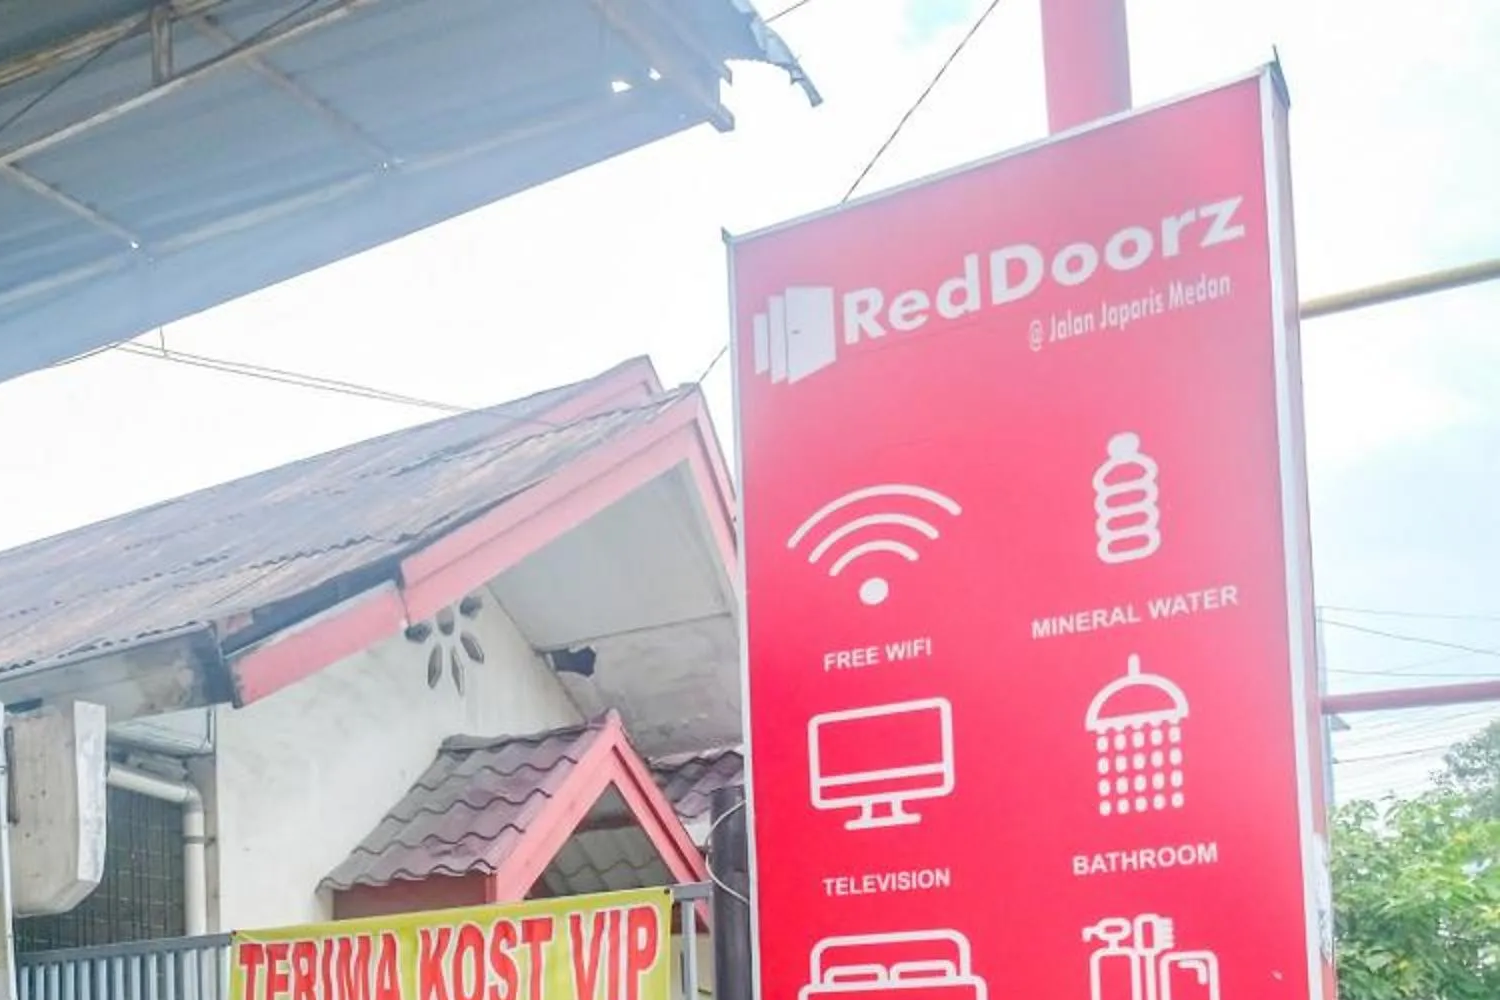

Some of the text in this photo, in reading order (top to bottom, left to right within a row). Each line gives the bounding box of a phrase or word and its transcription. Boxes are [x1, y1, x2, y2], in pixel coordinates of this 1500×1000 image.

[843, 196, 1245, 346] RedDoorz
[1029, 273, 1231, 351] @ Jalan Japaris Medan
[1031, 585, 1238, 640] MINERAL WATER
[822, 638, 933, 672] FREE WIFI
[1072, 841, 1219, 876] BATHROOM
[822, 867, 951, 897] TELEVISION
